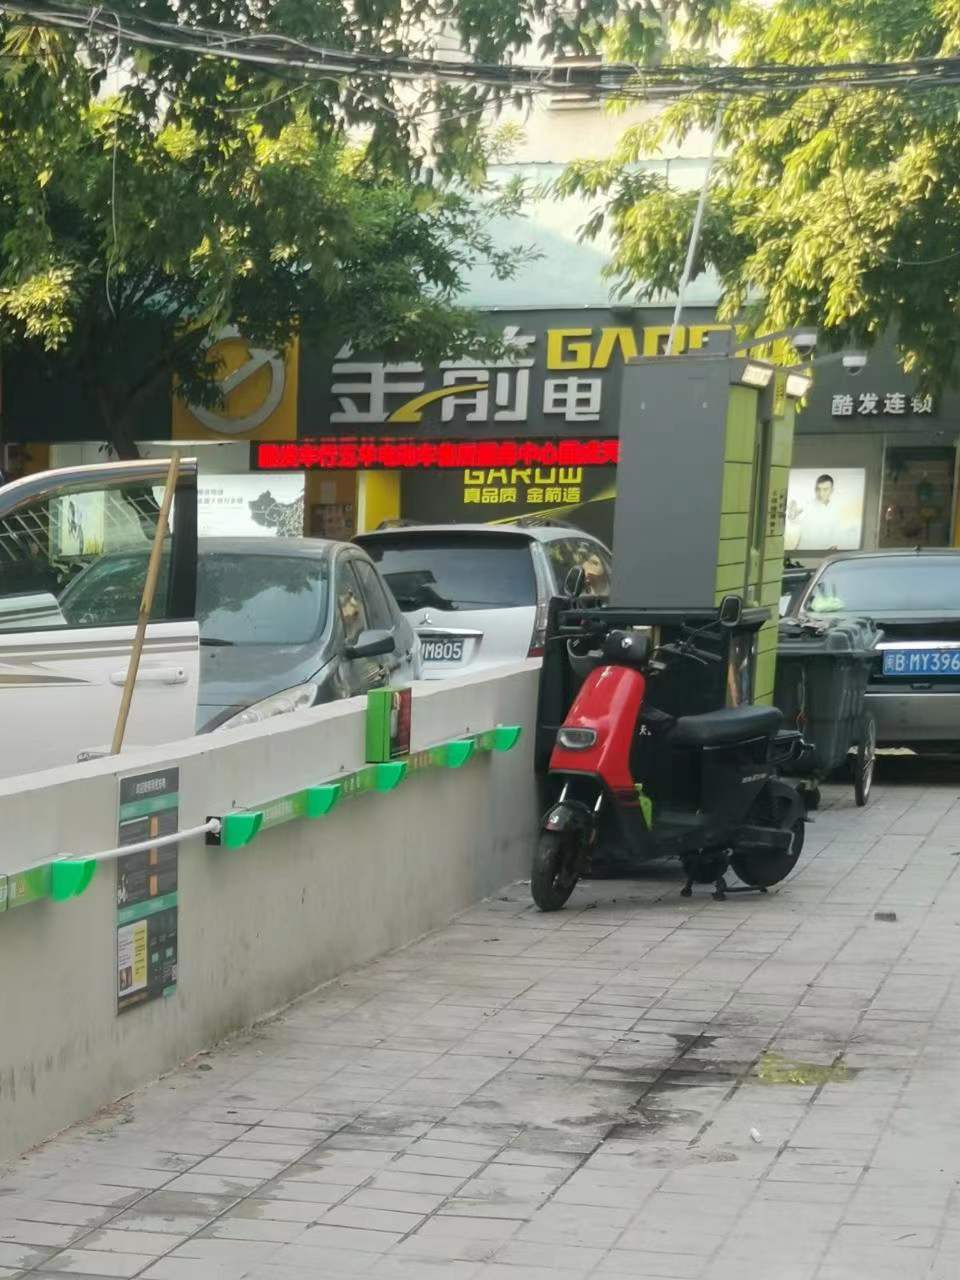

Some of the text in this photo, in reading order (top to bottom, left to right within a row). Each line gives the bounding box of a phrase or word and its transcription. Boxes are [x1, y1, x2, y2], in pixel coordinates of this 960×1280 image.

[463, 487, 517, 503] 真品质
[422, 642, 462, 659] M805
